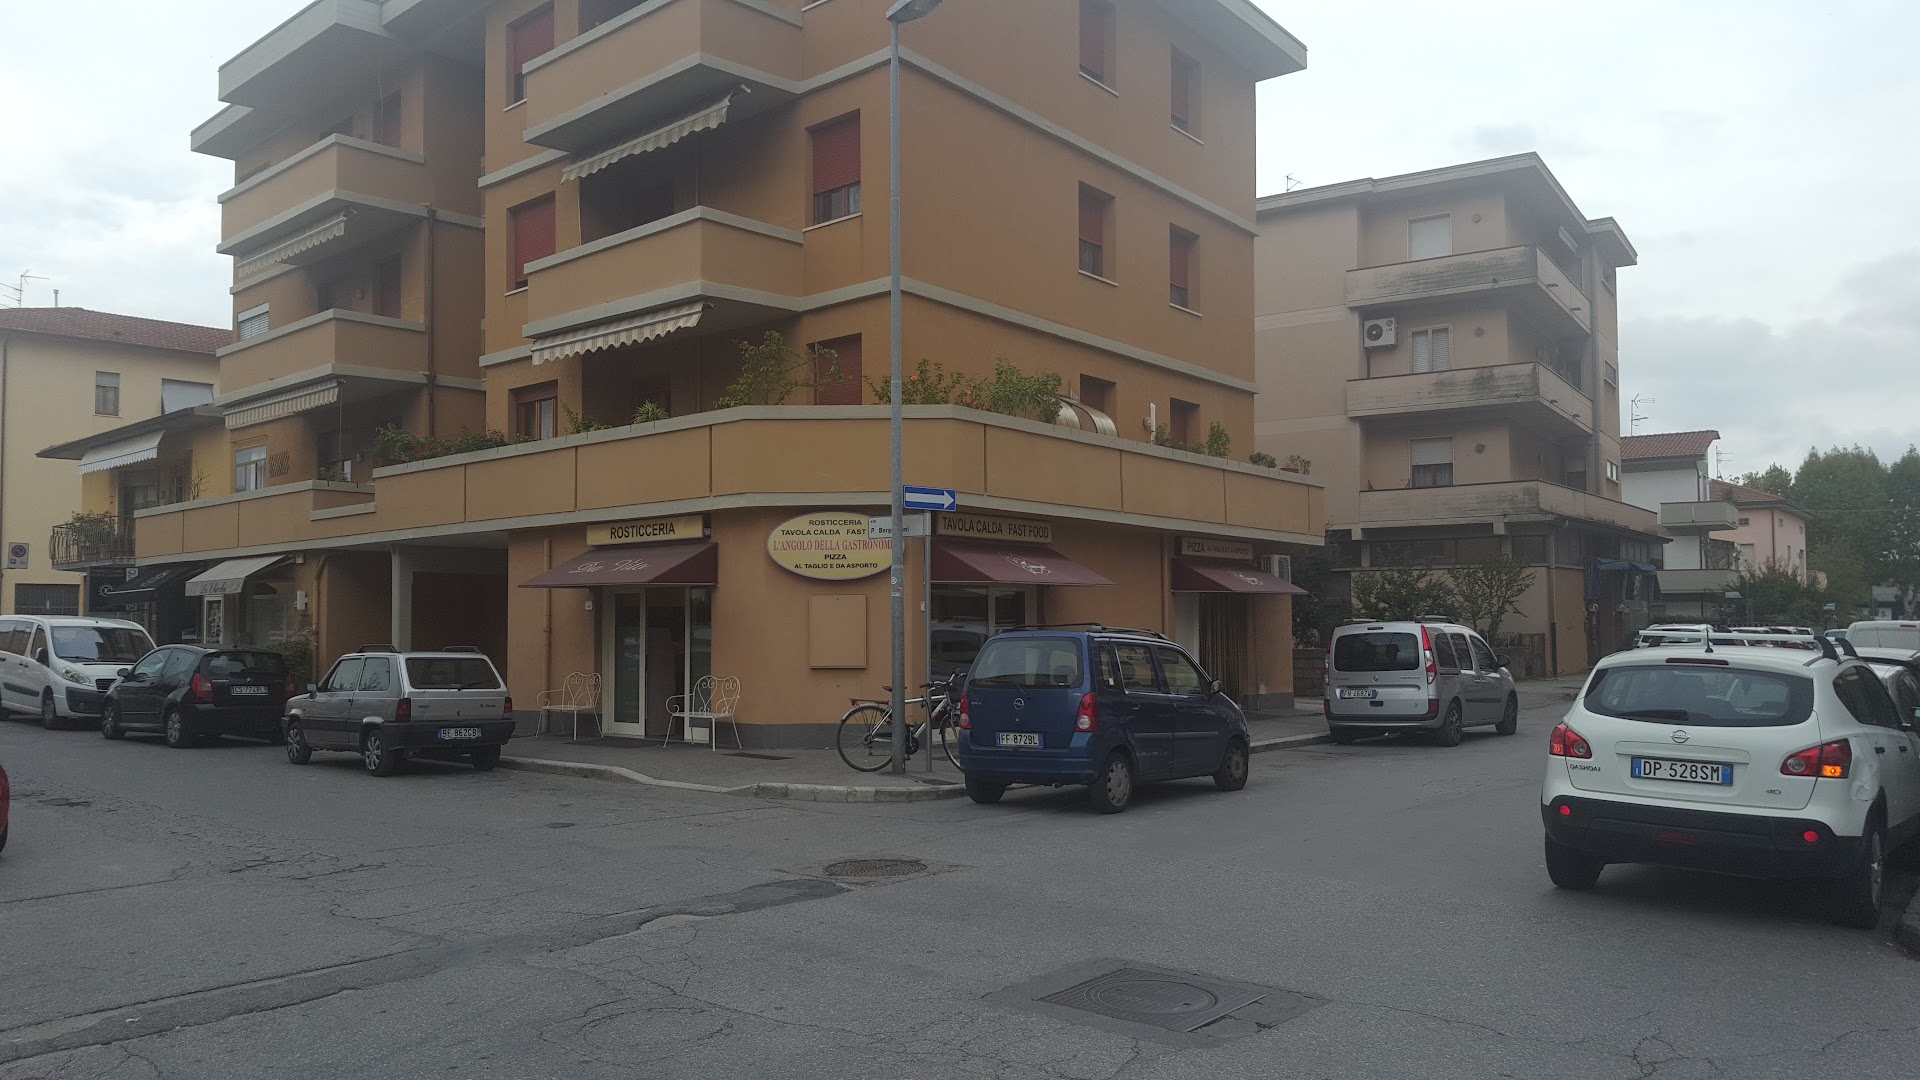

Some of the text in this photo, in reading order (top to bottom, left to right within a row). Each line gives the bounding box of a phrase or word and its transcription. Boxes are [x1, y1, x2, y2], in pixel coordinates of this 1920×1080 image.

[610, 522, 676, 540] ROSTICCERIA
[846, 528, 867, 536] FAST
[943, 517, 1049, 539] TAVOLA CALDA FAST FOOD
[773, 540, 812, 551] L'ANGOLO
[815, 540, 840, 551] DELLA
[1187, 541, 1206, 553] PIZZA
[1013, 734, 1038, 744] 872BL
[1569, 764, 1601, 772] QASHQAI
[1669, 763, 1720, 782] 528SM
